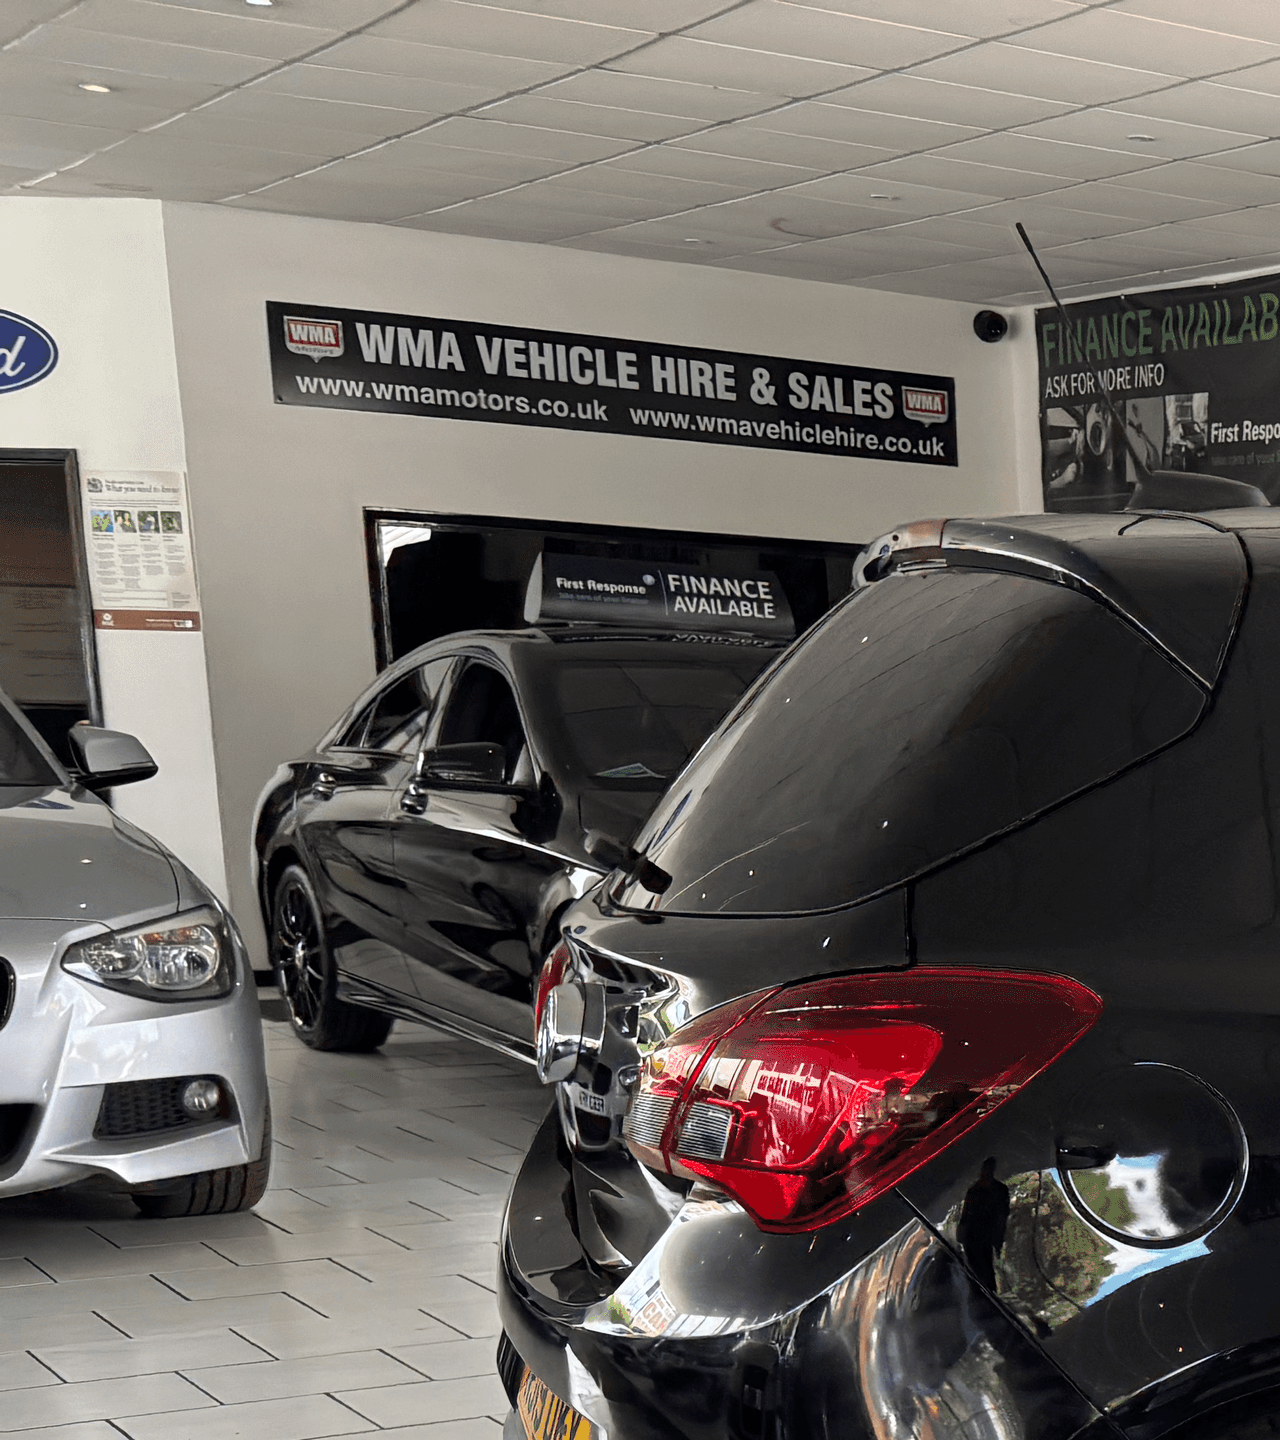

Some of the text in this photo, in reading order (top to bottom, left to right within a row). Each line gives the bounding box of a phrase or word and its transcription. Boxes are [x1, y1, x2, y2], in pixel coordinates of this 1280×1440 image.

[290, 323, 336, 344] WMA
[1042, 309, 1153, 368] FINANCE
[355, 323, 894, 419] WMA VEHICLE HIRE & SALES
[1045, 362, 1165, 399] ASK FOR MORE INFO
[906, 392, 942, 412] WMA
[295, 375, 945, 457] www.wmamotors.co.uk www.wmavehiclehire.co.uk
[1210, 422, 1240, 443] First
[556, 577, 647, 595] First Response
[667, 573, 773, 599] FINANCE
[674, 595, 776, 619] AVAILABLE
